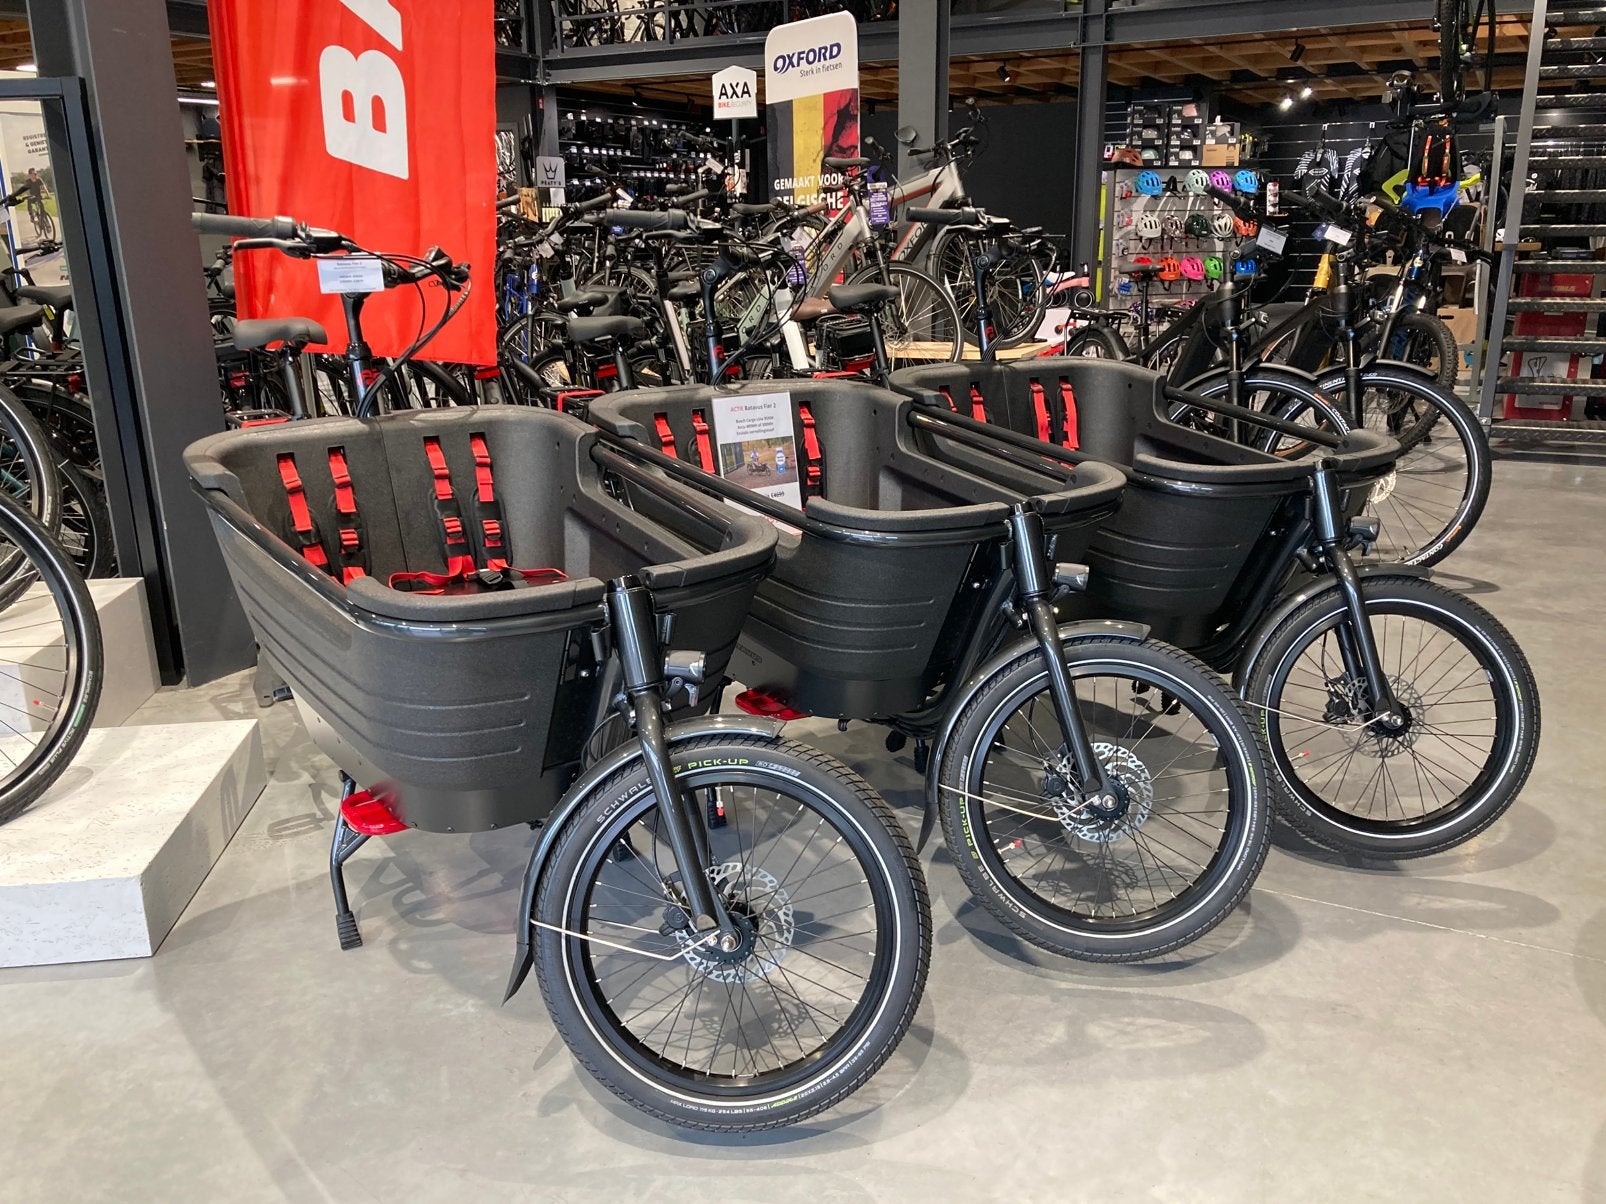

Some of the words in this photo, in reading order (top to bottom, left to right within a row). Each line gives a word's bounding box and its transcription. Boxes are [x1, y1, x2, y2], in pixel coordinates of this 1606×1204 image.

[773, 42, 842, 74] OXFORD
[800, 66, 815, 78] Sterk
[815, 66, 821, 75] in
[821, 62, 843, 74] fietsen
[718, 81, 752, 100] AXA
[774, 176, 815, 191] GEMAAKT
[688, 758, 749, 770] PICK-UP
[959, 797, 974, 847] PICK-UP
[978, 864, 1027, 920] SCHWALBE
